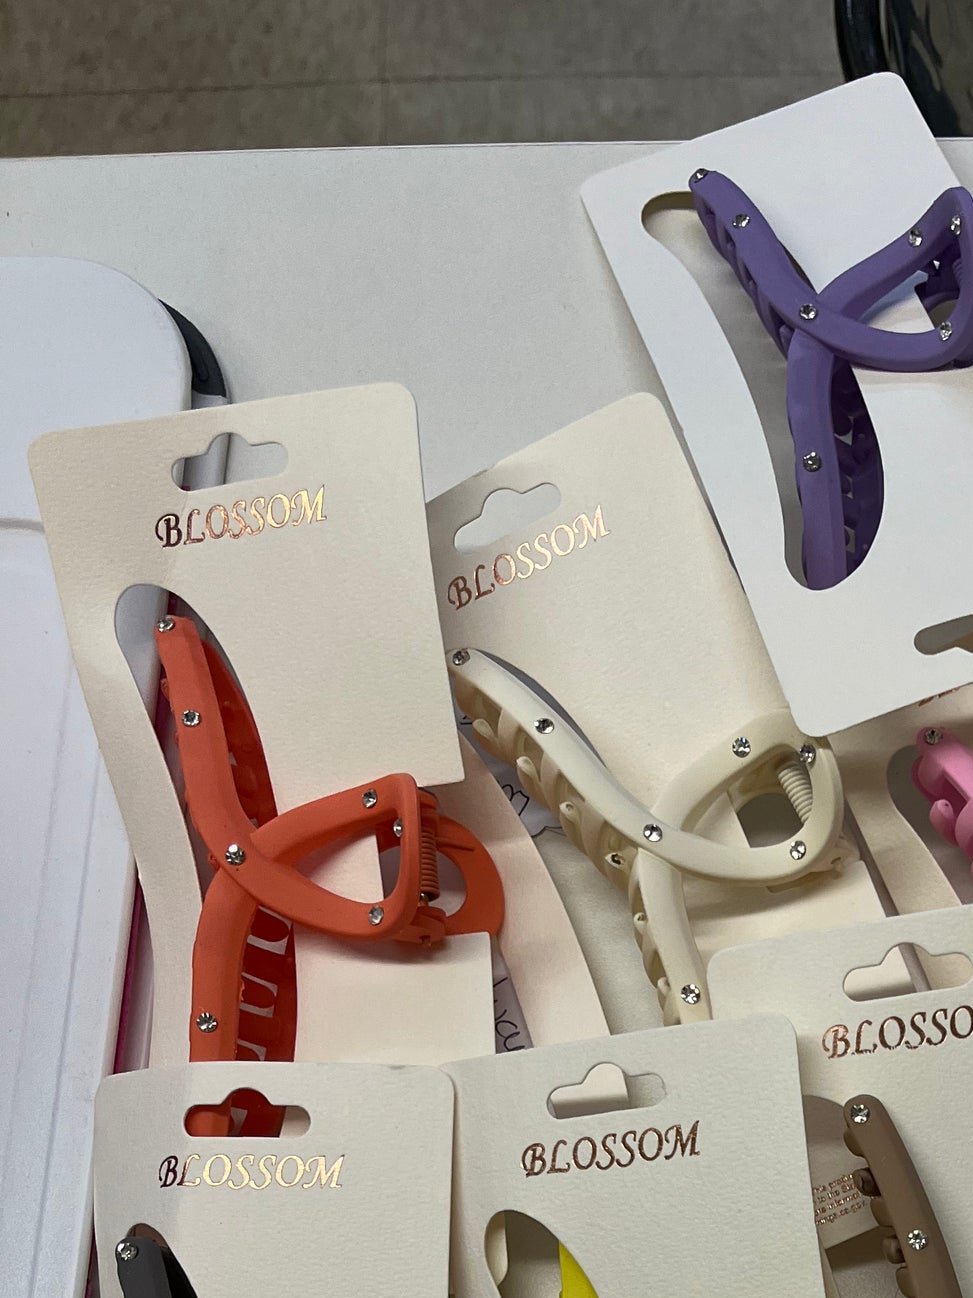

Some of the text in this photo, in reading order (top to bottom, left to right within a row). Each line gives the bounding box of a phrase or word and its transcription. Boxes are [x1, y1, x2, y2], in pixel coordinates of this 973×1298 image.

[155, 485, 327, 549] BLOSSOM
[447, 505, 611, 610] BLOSSOM
[159, 1154, 345, 1190] BLOSSOM
[521, 1120, 700, 1177] BLOSSOM
